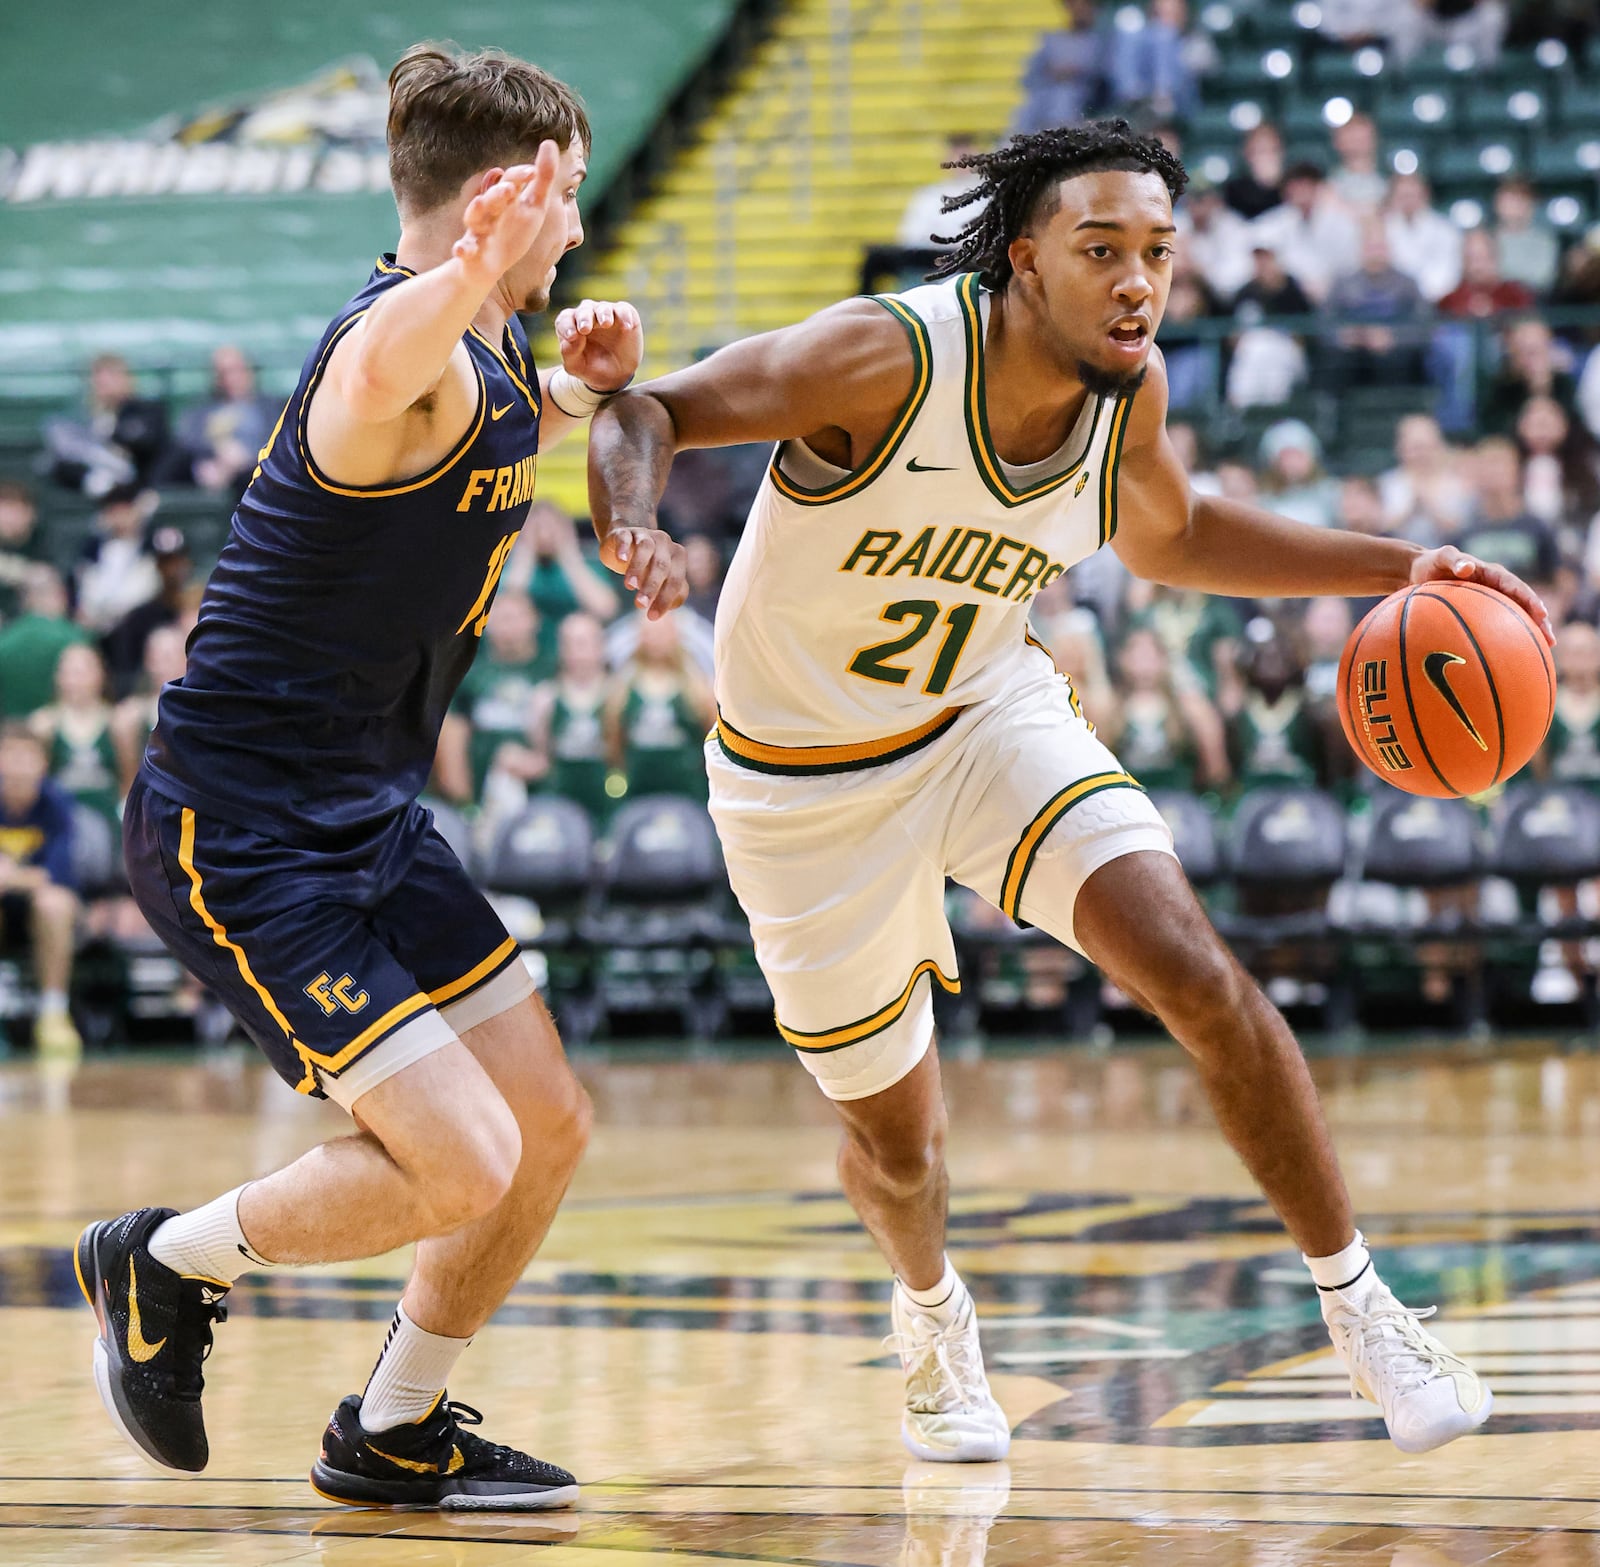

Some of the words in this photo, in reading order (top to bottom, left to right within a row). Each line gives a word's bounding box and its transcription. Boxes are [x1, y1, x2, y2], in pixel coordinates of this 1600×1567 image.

[844, 599, 982, 698] 21
[1364, 659, 1415, 772] ELITE
[302, 969, 371, 1018] FC
